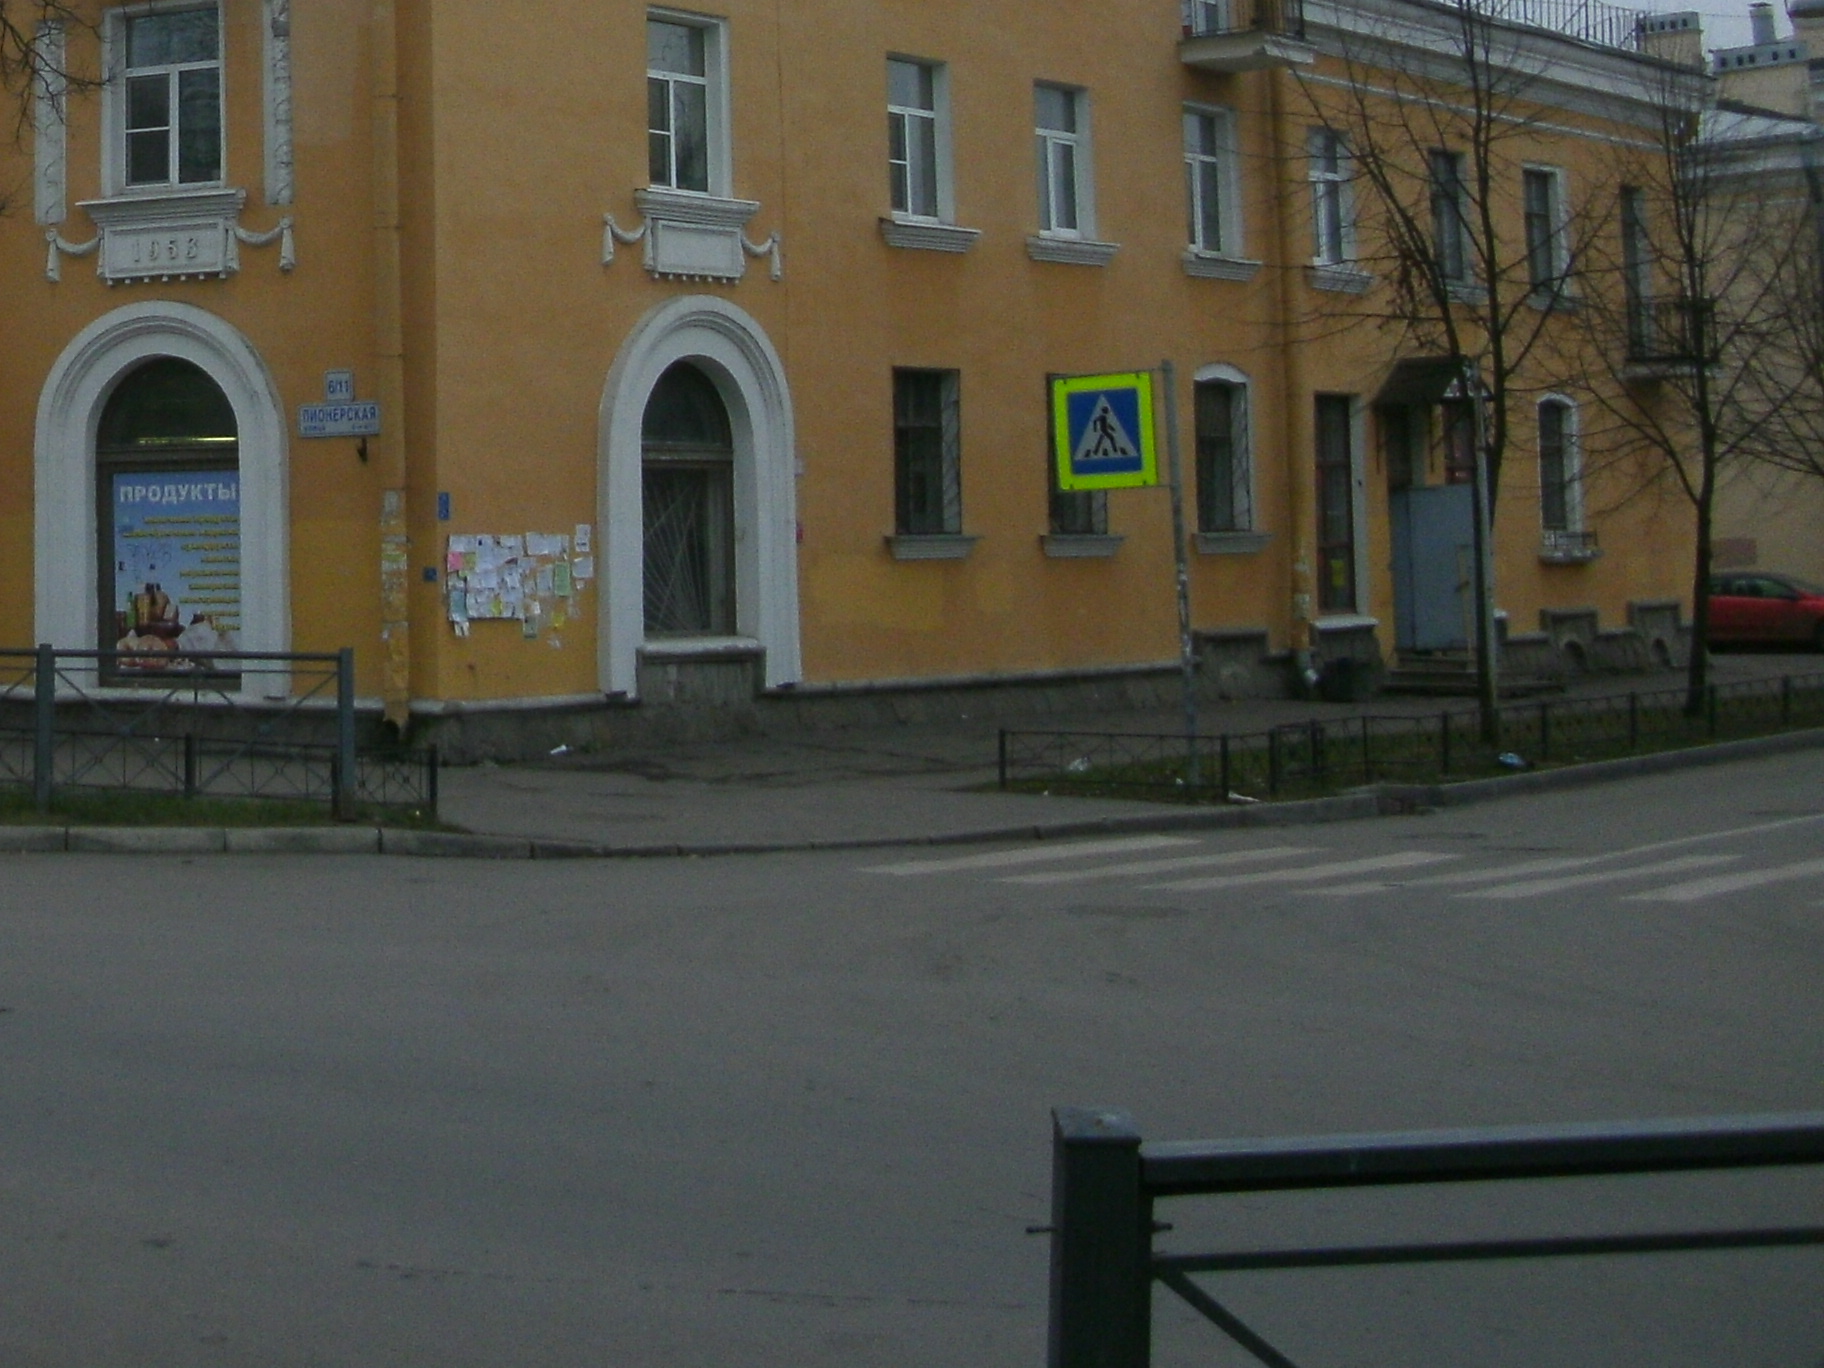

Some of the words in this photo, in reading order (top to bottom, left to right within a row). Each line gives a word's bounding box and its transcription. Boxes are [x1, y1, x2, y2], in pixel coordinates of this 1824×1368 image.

[328, 380, 349, 394] 6/11
[303, 406, 376, 423] ПИОНЕРСКАЯ
[119, 483, 237, 505] ПРОДУКТЫ
